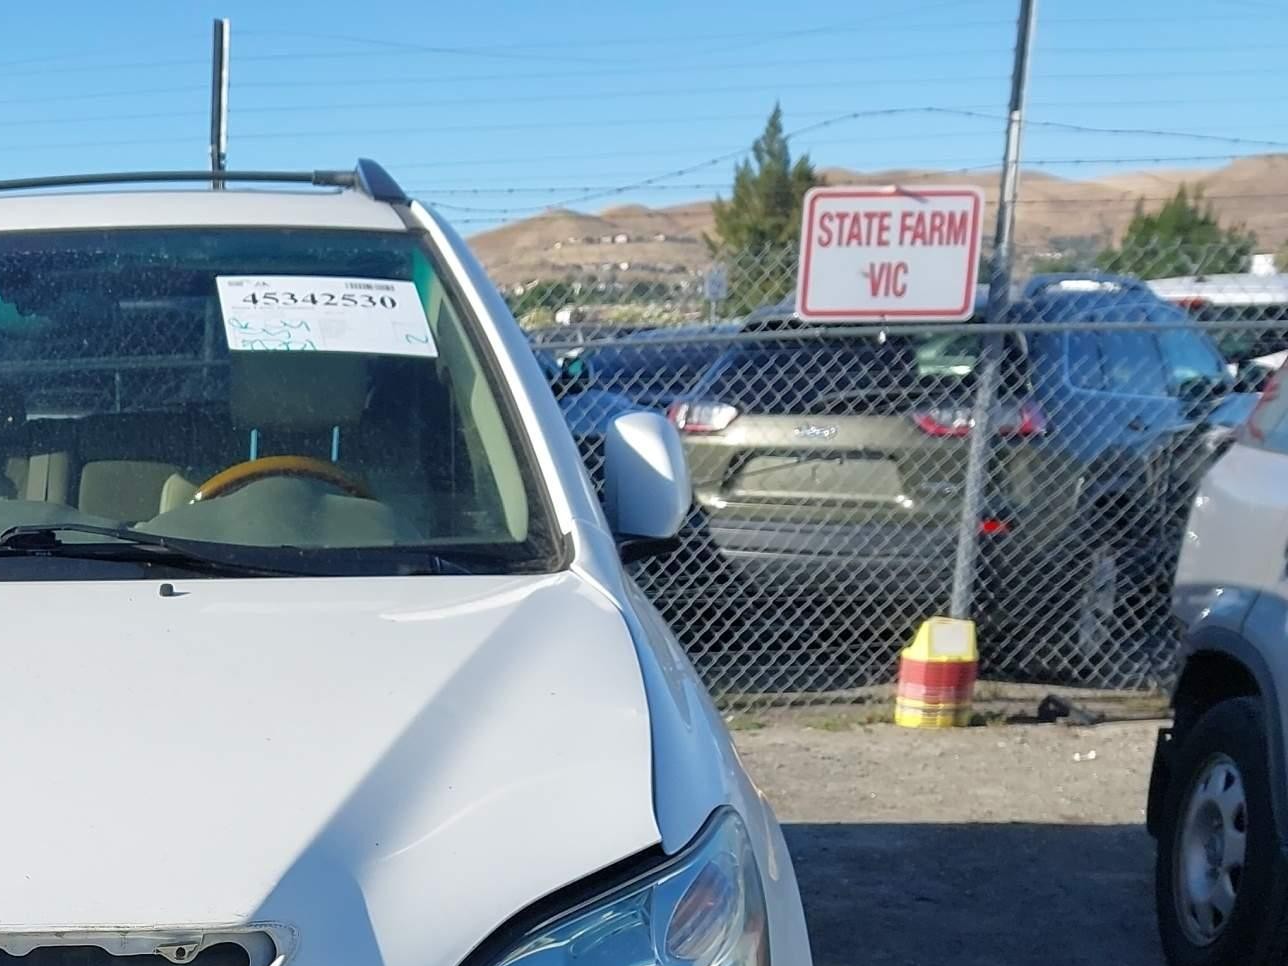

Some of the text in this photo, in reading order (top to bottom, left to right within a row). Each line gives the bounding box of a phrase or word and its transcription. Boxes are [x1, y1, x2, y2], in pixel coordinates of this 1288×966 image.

[817, 210, 969, 248] STATE FARM
[869, 261, 909, 298] VIC
[242, 291, 398, 309] 45342530
